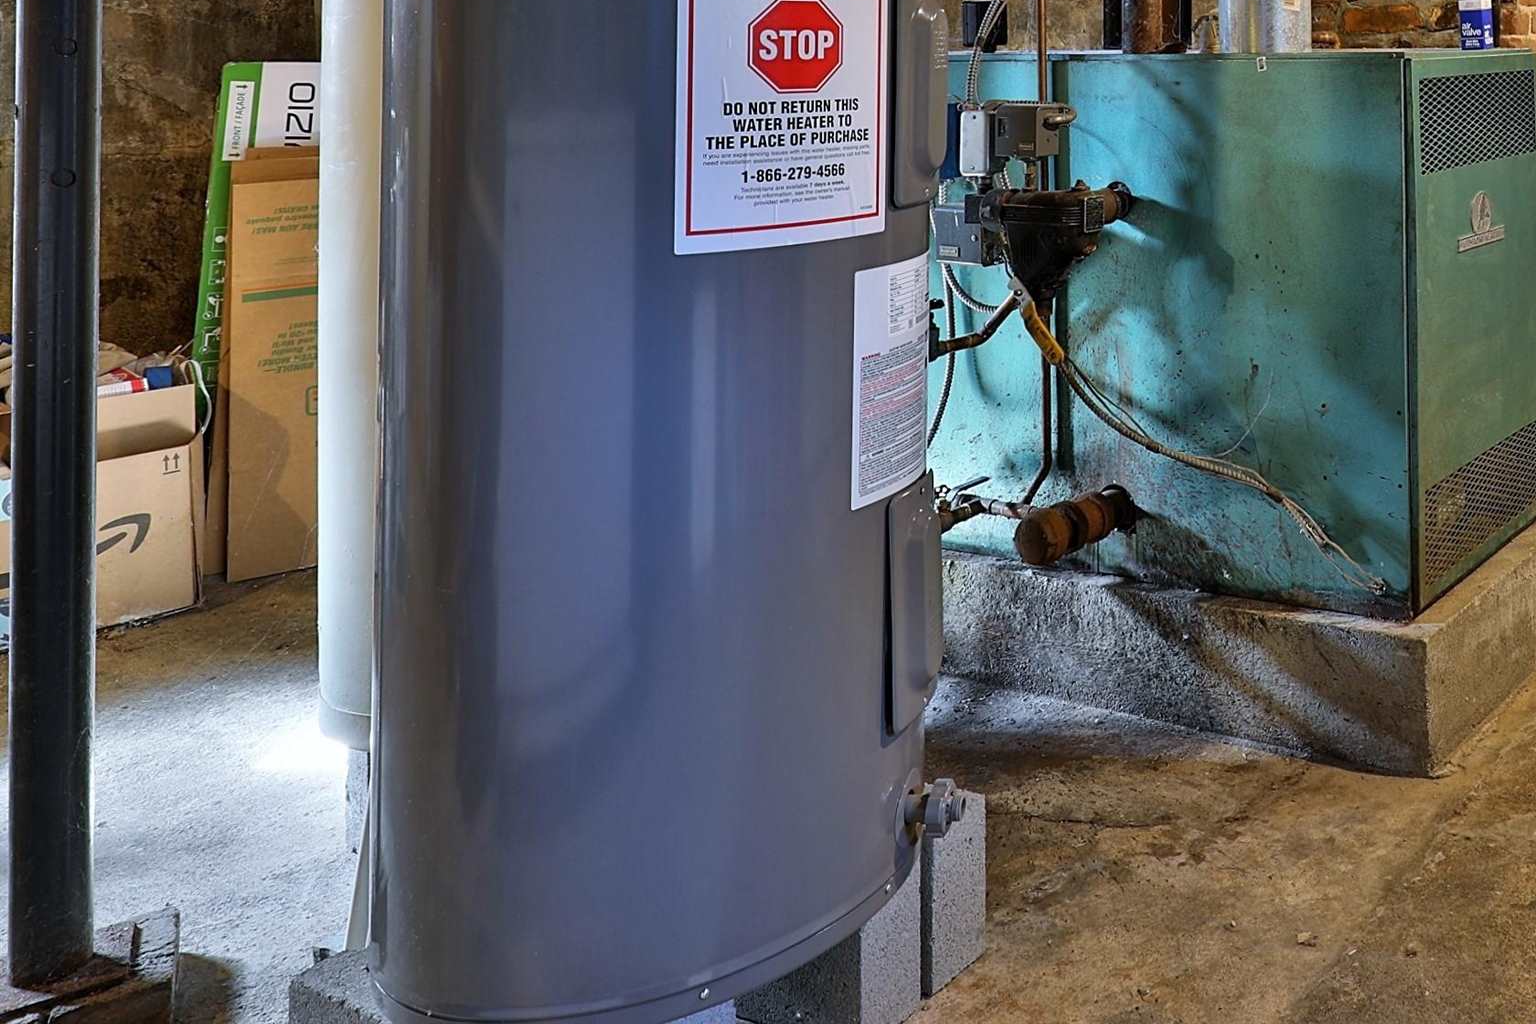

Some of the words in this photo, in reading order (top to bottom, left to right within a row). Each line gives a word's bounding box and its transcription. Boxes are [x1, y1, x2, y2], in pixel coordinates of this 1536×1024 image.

[1462, 28, 1482, 36] valve
[759, 29, 834, 61] STOP
[234, 92, 246, 119] FAÇADE
[723, 102, 743, 116] DO
[748, 101, 777, 115] NOT
[781, 99, 831, 114] RETURN
[834, 98, 859, 112] THIS
[733, 118, 782, 132] WATER
[787, 115, 834, 130] HEATER
[838, 114, 852, 127] TO
[231, 125, 242, 150] FRONT
[706, 136, 734, 150] THE
[740, 134, 785, 149] PLACE
[790, 133, 806, 146] OF
[811, 128, 869, 144] PURCHASE
[741, 163, 845, 183] 1-866-279-4566
